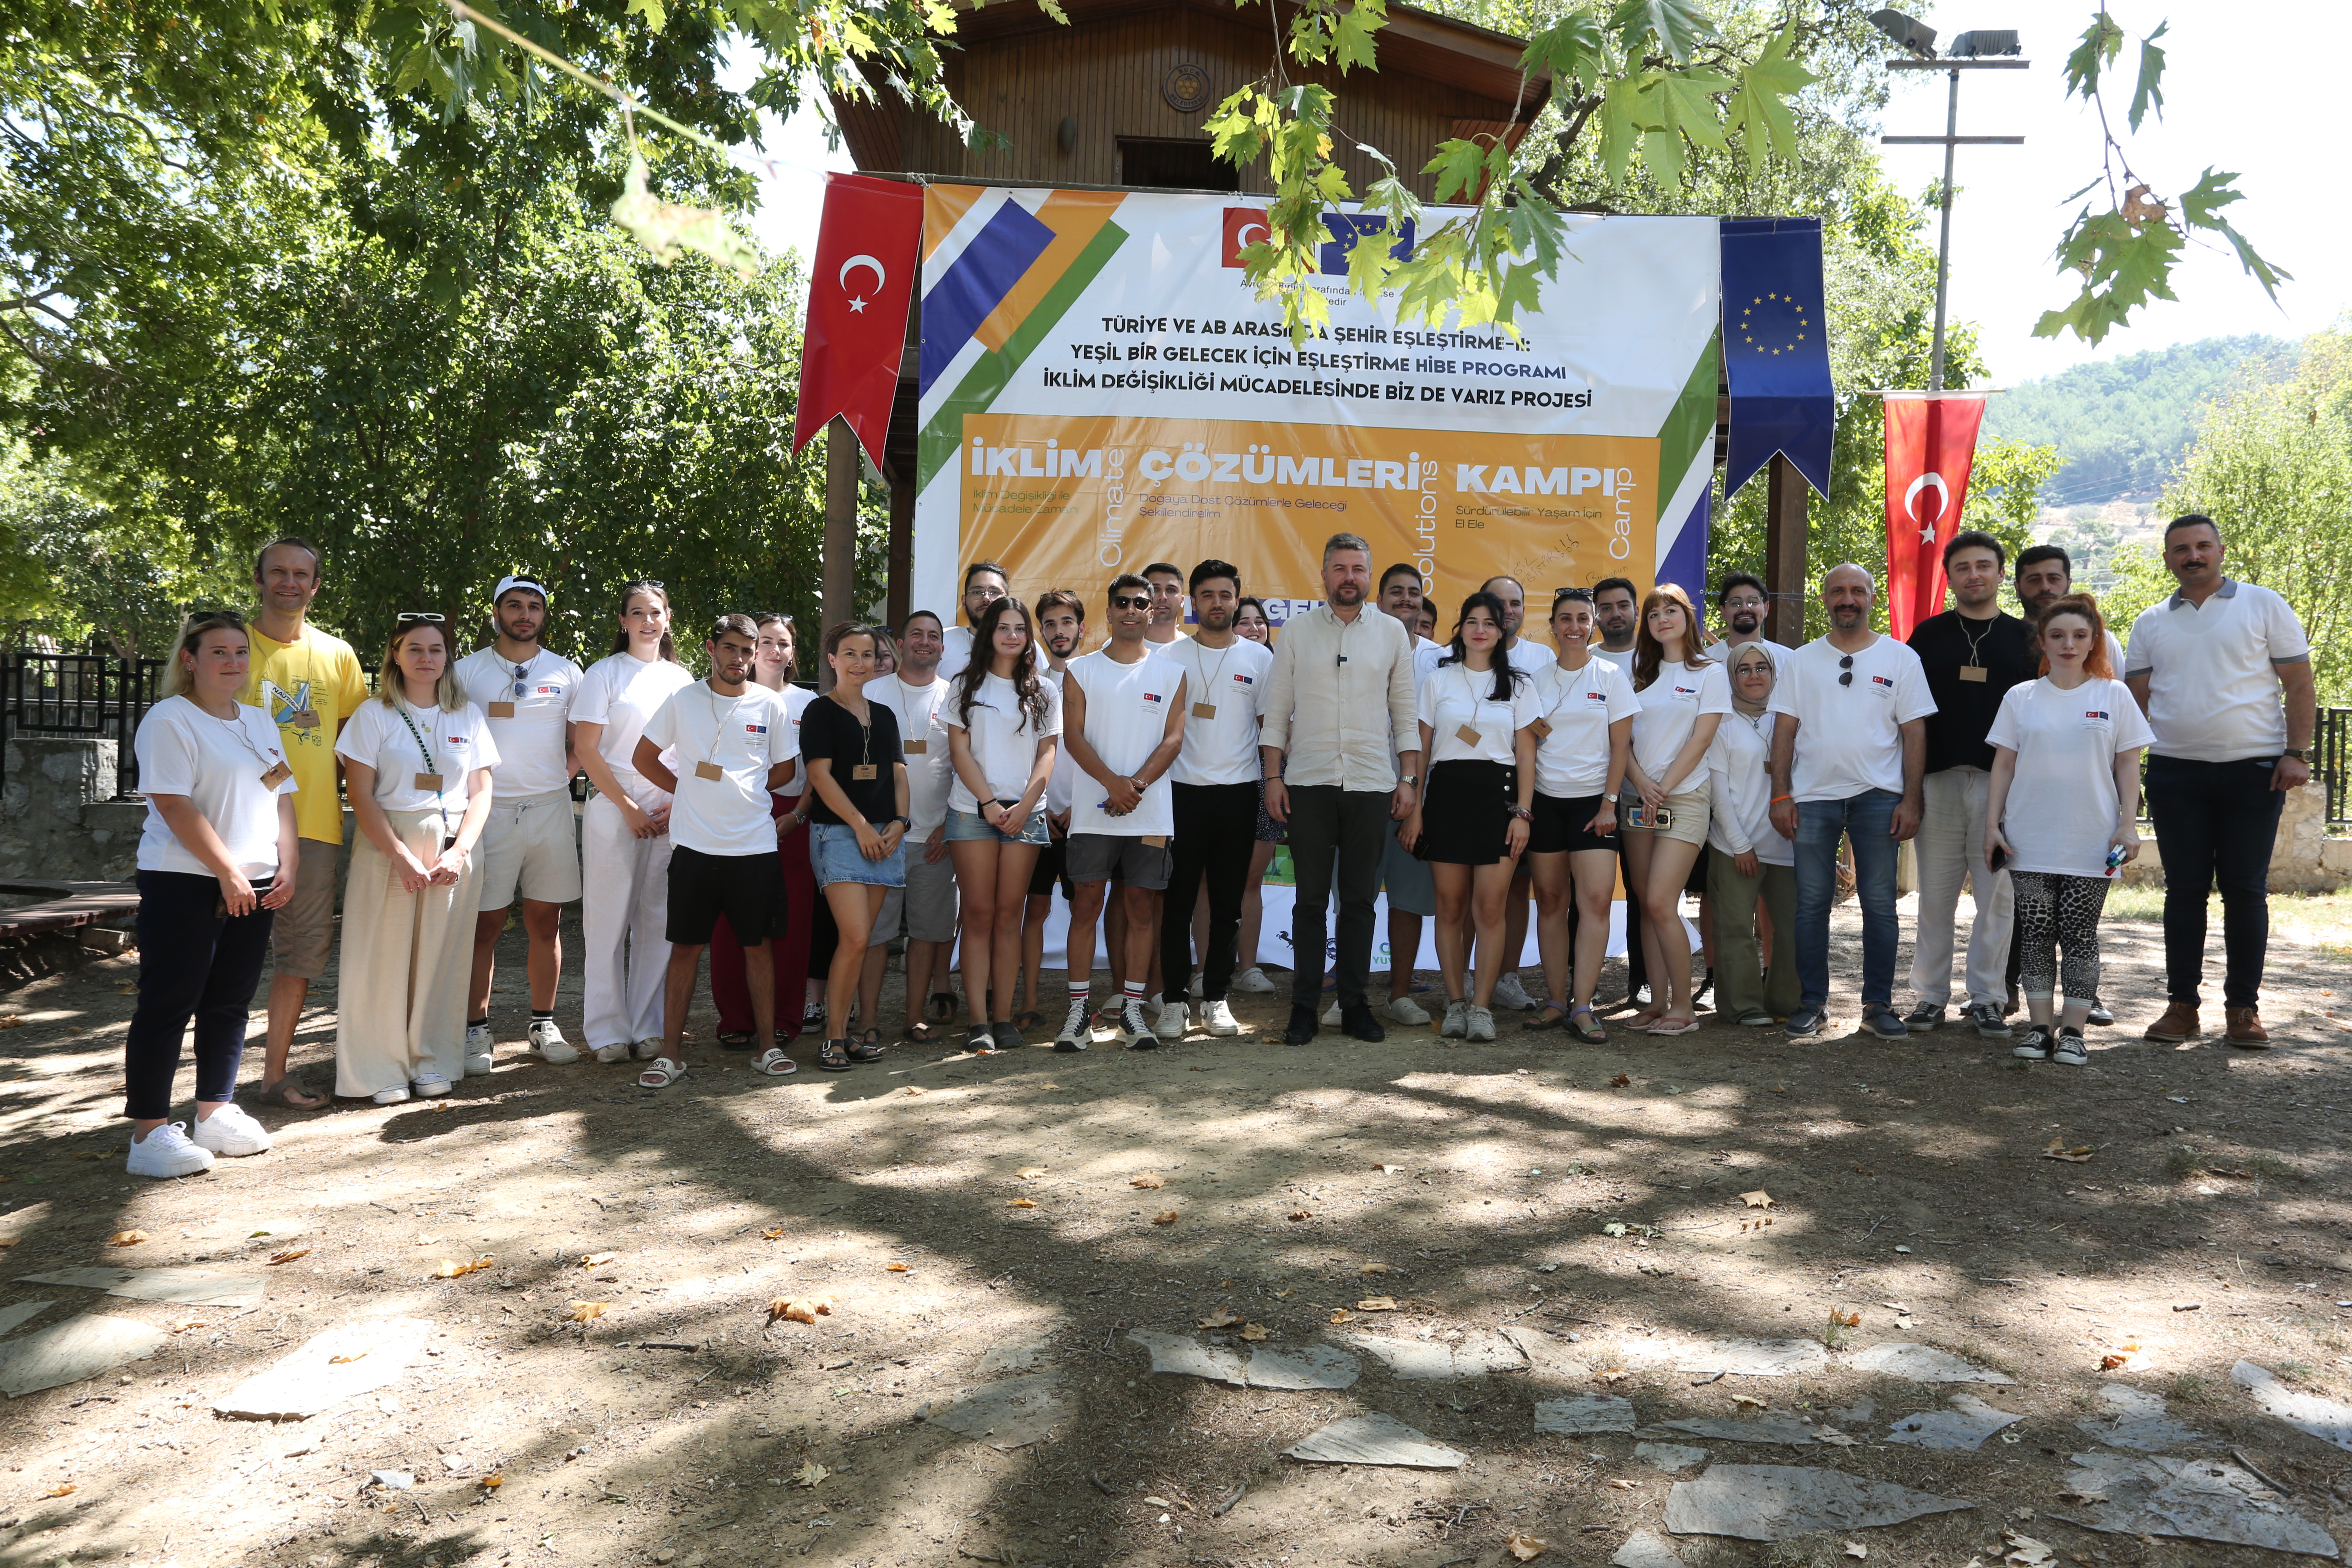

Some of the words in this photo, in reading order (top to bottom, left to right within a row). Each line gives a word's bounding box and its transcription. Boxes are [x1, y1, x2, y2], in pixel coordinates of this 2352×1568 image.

[1178, 68, 1200, 77] BUCA
[1169, 94, 1203, 106] BELEDİYESİ
[1102, 315, 1167, 333] TÜRİYE
[1173, 318, 1195, 333] VE
[1201, 320, 1226, 334] AB
[1334, 325, 1387, 345] ŞEHİR
[1071, 341, 1122, 364] YEŞİL
[1128, 341, 1157, 361] BİR
[1163, 347, 1247, 363] GELECEK
[1254, 345, 1291, 369] İÇİN
[1298, 352, 1410, 373] EŞLEŞTİRME
[1416, 355, 1456, 374] HİBE
[1463, 361, 1566, 379] PROGRAMI
[1044, 367, 1096, 388] İKLİM
[1102, 370, 1214, 394] DEĞİŞİKLİĞİ
[1220, 374, 1379, 399] MÜCADELESİNDE
[1385, 381, 1414, 401] BİZ
[1421, 387, 1445, 402] DE
[1451, 388, 1505, 405] VARIZ
[1511, 389, 1592, 408] PROJESİ
[971, 436, 1102, 478] İKLİM
[1139, 441, 1420, 490] ÇÖZÜMLERİ
[1456, 464, 1615, 497] KAMPI
[973, 487, 997, 499] İklim
[1001, 490, 1056, 502] Değişikliği
[1059, 491, 1070, 500] ile
[1139, 493, 1188, 506] Doğaya
[1191, 494, 1221, 505] Dost
[1225, 495, 1292, 508] Çözümlerle
[1294, 498, 1348, 512] Geleceği
[973, 503, 1032, 513] Mücadele
[1036, 505, 1079, 513] Zamanı
[1100, 448, 1125, 567] Climate
[1139, 506, 1221, 519] Şekillendirelim
[1456, 506, 1533, 516] Sürdürülebilir
[1537, 508, 1580, 519] Yaşam
[1583, 506, 1602, 519] İçin
[1609, 467, 1637, 560] Camp
[1412, 460, 1438, 596] Solutions
[1455, 519, 1465, 528] El
[1468, 519, 1485, 529] Ele
